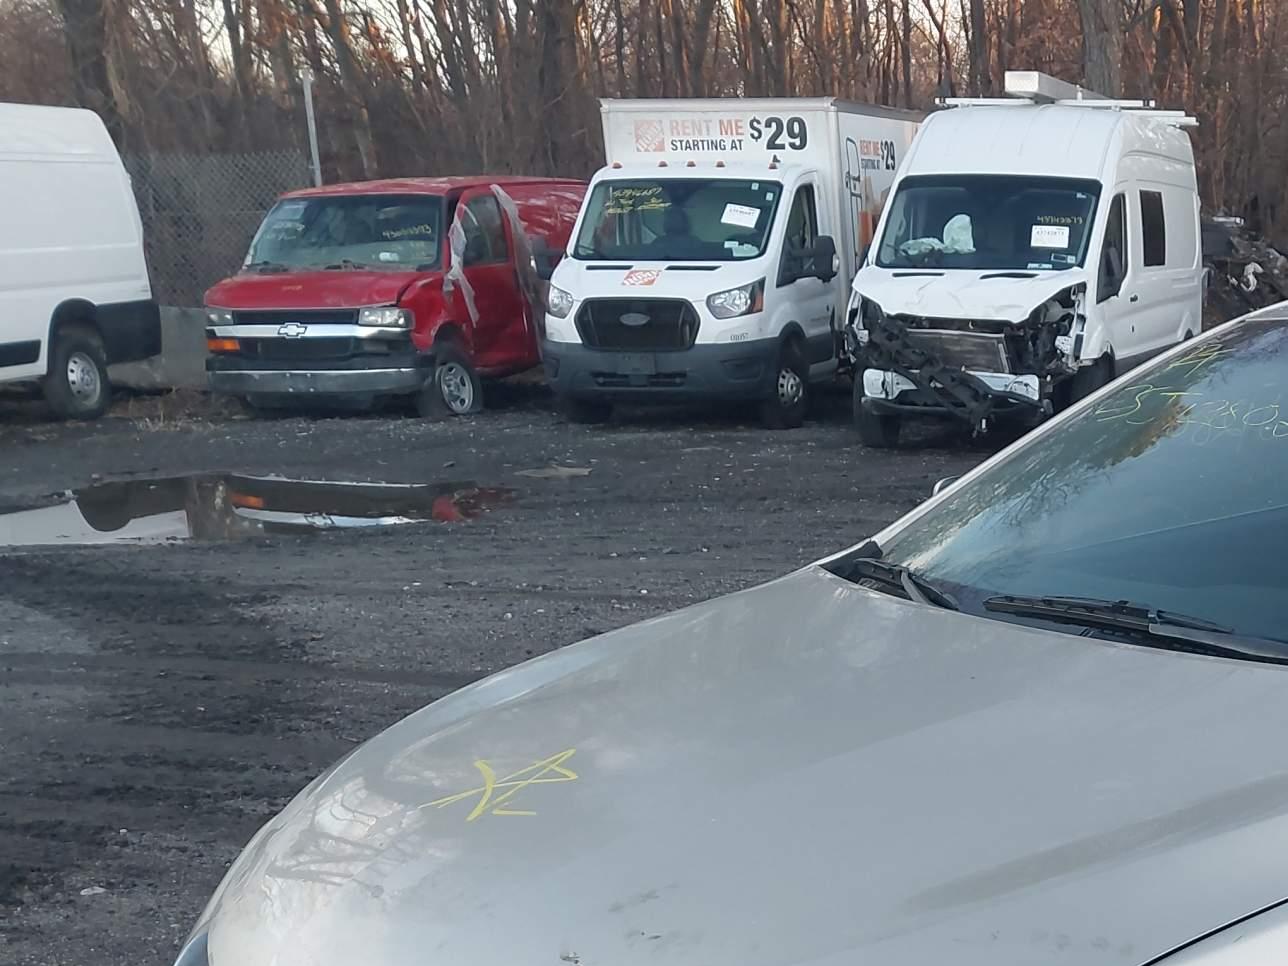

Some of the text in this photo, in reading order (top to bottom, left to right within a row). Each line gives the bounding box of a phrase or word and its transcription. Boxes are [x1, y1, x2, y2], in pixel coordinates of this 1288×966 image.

[669, 119, 713, 136] RENT
[718, 119, 745, 136] ME
[749, 116, 808, 151] $29
[670, 138, 744, 151] STARTING AT
[880, 139, 896, 171] $29
